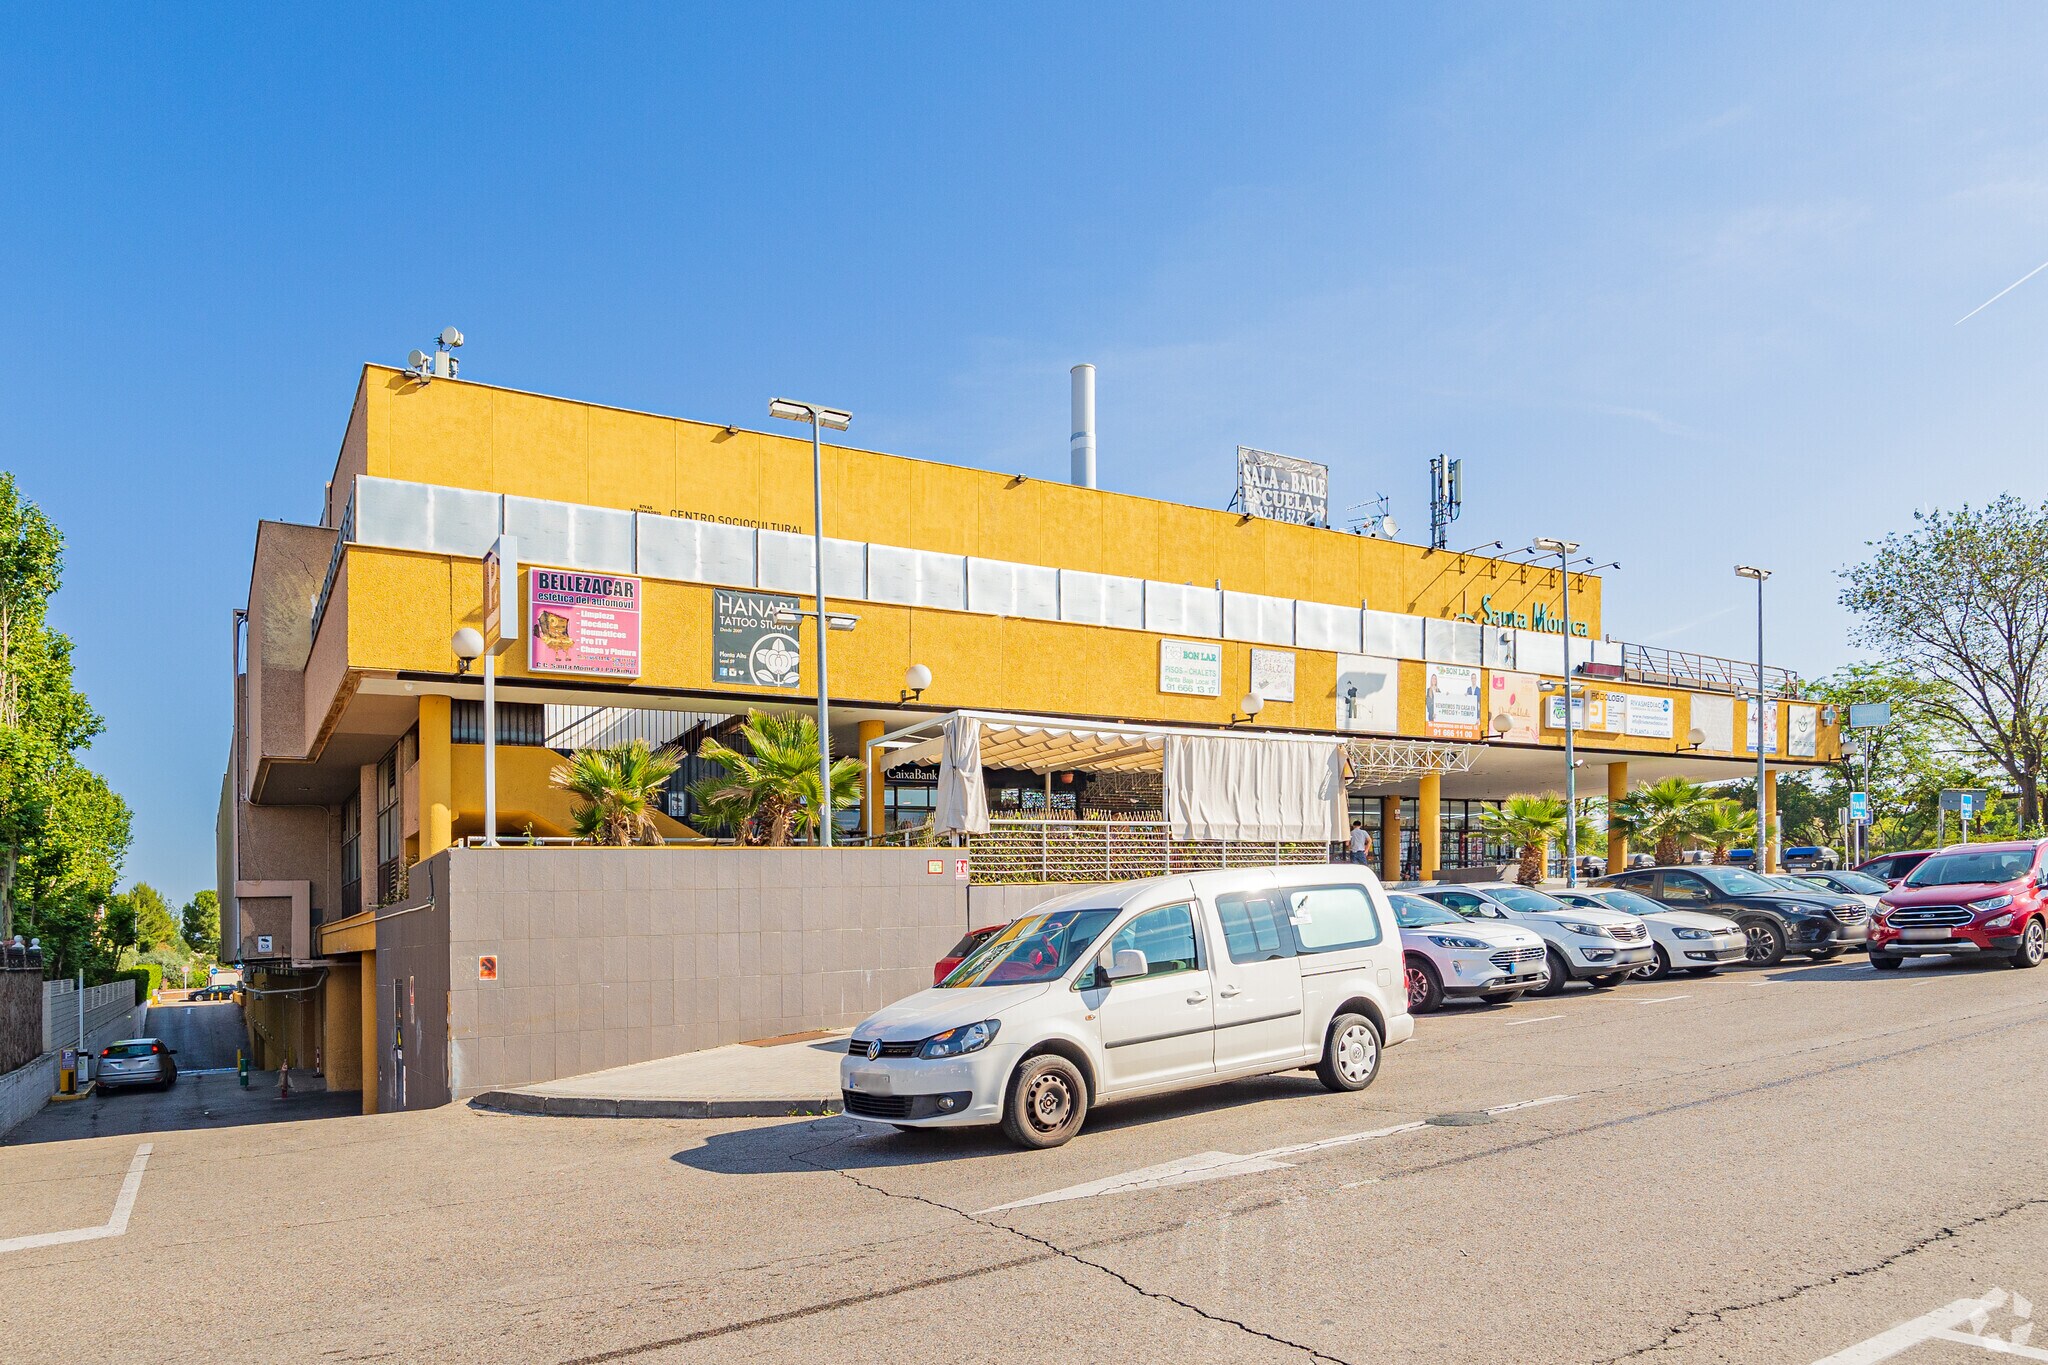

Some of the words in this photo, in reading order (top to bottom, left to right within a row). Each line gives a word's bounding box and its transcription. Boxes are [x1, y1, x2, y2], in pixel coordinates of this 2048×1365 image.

[1244, 464, 1279, 490] SALA
[1281, 480, 1290, 491] de
[1291, 472, 1326, 500] BAILE
[1244, 485, 1314, 513] ESCUELA
[670, 509, 714, 524] CENTRO
[538, 572, 634, 598] BELLEZACAR
[538, 592, 574, 603] estética
[576, 596, 590, 605] del
[1482, 594, 1528, 629] Santa
[720, 616, 758, 628] TATTOO
[595, 638, 608, 646] ITV
[1183, 650, 1198, 660] BON
[1201, 652, 1216, 662] LAR
[1189, 668, 1216, 678] CHALETS
[886, 767, 938, 780] CaixaBank
